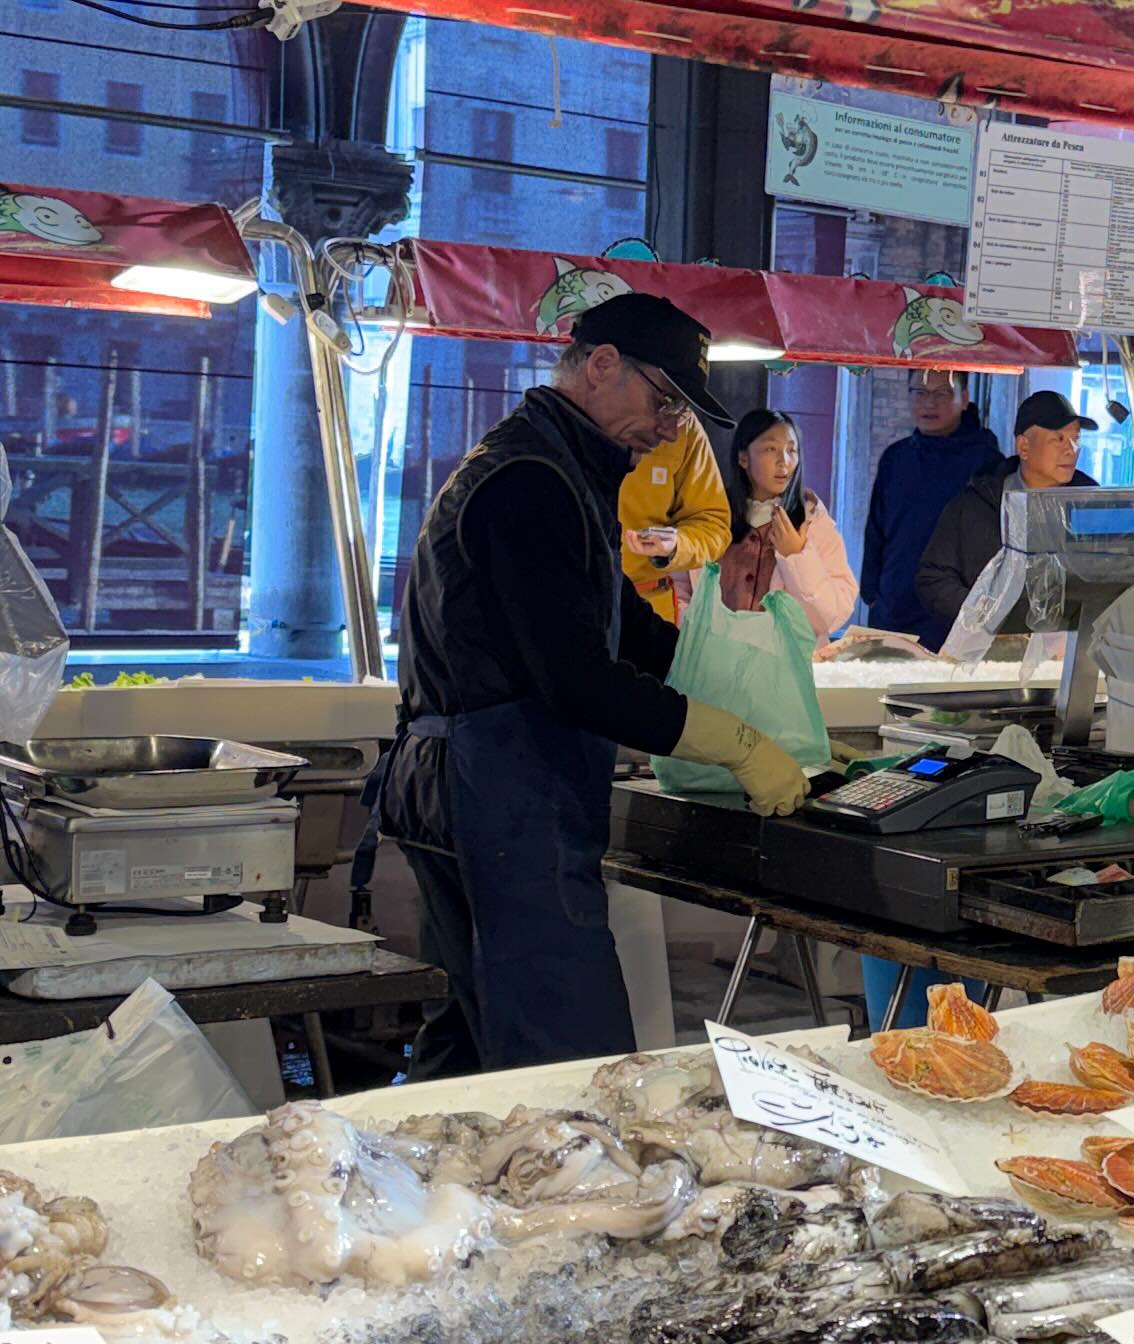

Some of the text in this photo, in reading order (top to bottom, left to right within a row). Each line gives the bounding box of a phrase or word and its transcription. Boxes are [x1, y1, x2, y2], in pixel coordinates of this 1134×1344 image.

[835, 111, 961, 144] Informazioni al consumatore
[1001, 132, 1084, 152] Attrezzature da Pesca
